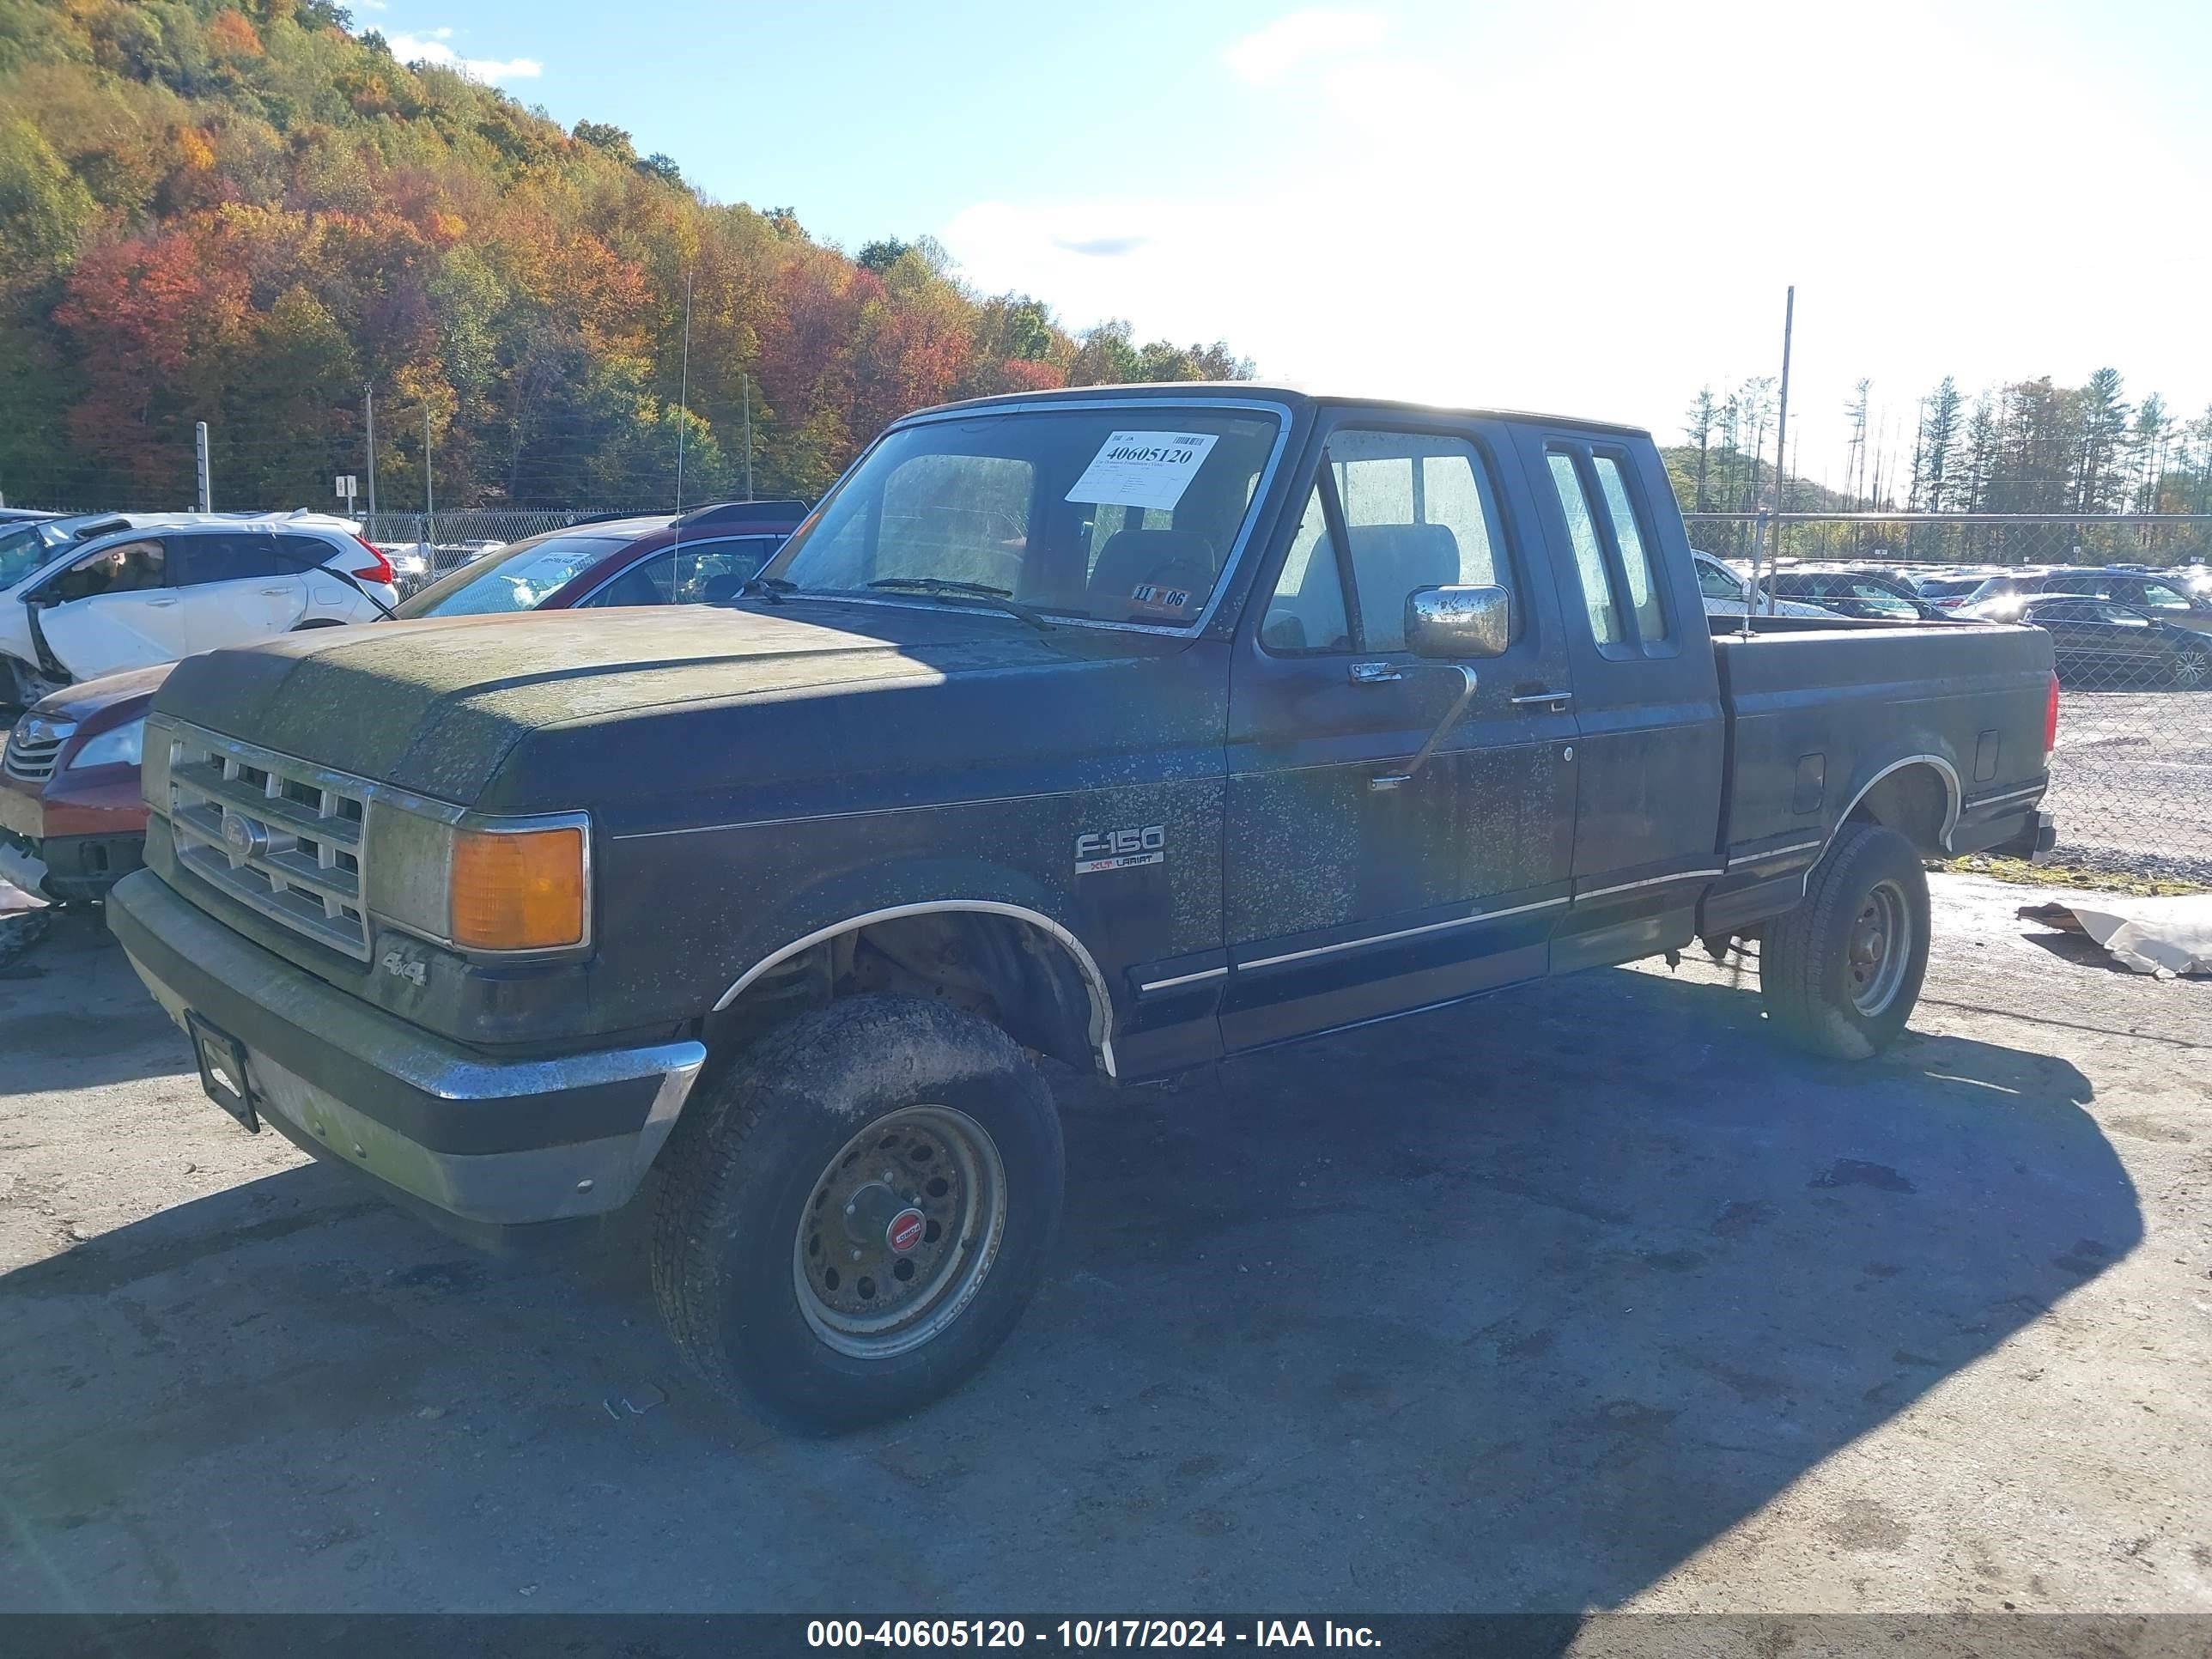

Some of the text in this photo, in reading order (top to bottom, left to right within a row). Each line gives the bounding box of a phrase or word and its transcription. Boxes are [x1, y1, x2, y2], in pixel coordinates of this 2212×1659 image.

[1107, 447, 1193, 465] 40605120
[1133, 586, 1152, 601] 11
[1167, 591, 1185, 606] 06
[1076, 825, 1165, 858] F-150
[1091, 855, 1152, 870] XLT LARIAT
